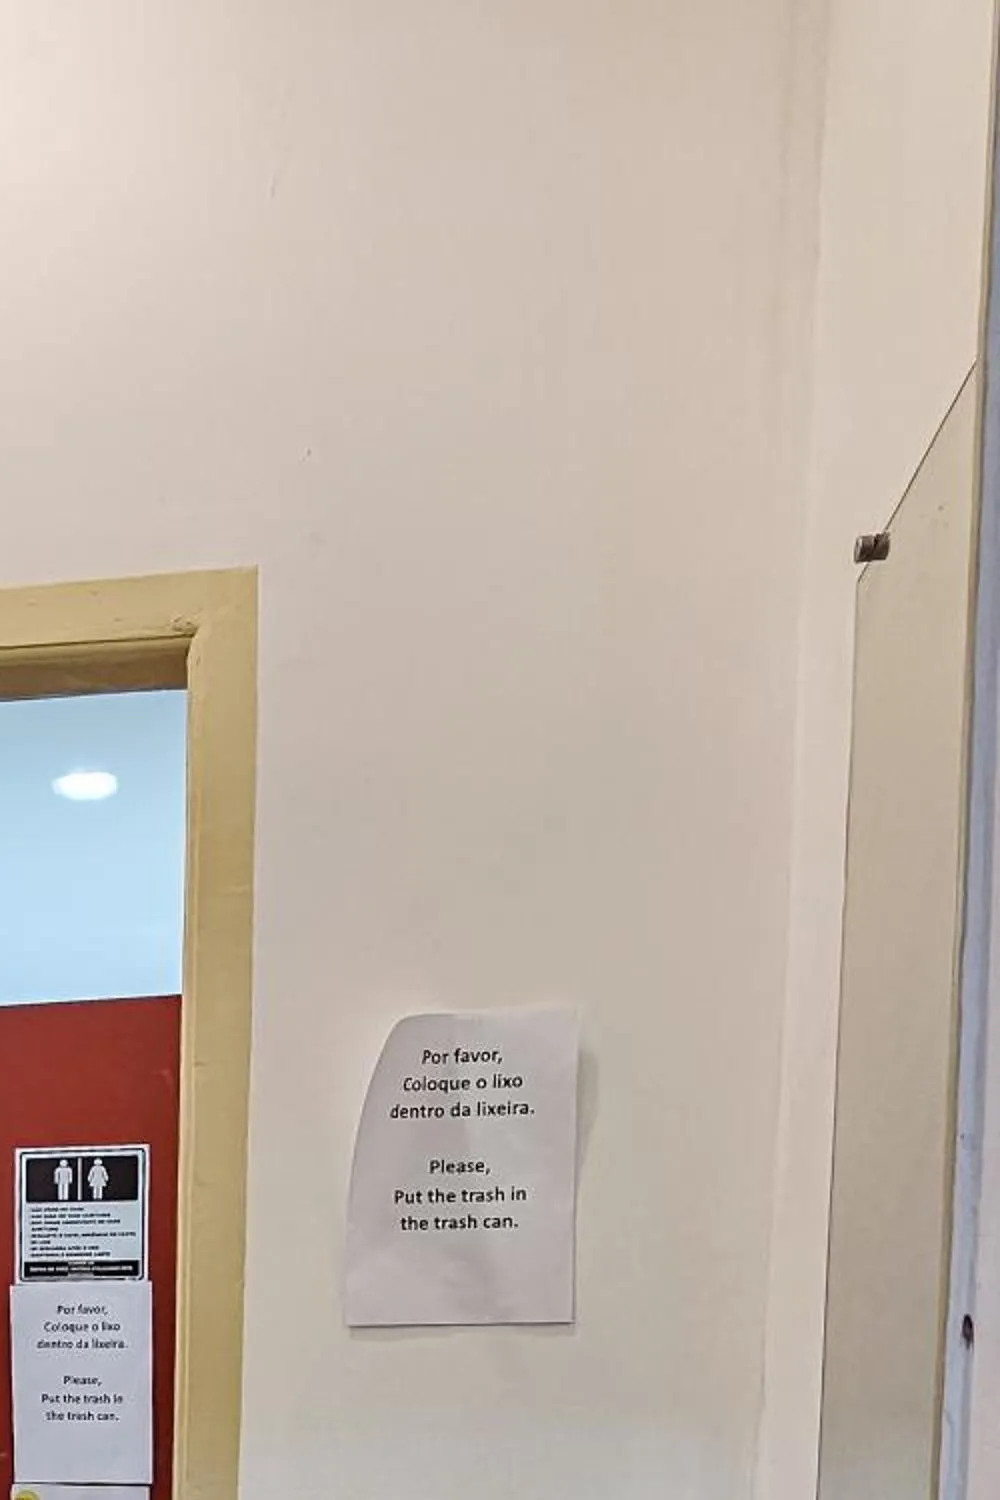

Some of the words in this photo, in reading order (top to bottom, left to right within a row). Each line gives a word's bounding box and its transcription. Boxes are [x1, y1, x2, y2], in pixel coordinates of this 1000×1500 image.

[422, 1050, 449, 1064] Por
[453, 1048, 503, 1065] favor,
[403, 1076, 470, 1093] Coloque
[476, 1079, 487, 1089] o
[492, 1075, 524, 1088] lixo
[390, 1104, 444, 1119] dentro
[450, 1102, 471, 1117] da
[477, 1100, 535, 1116] lixeira.
[429, 1159, 490, 1175] Please,
[394, 1190, 422, 1204] Put
[427, 1188, 456, 1204] the
[461, 1186, 505, 1203] trash
[511, 1186, 527, 1201] in
[400, 1216, 428, 1230] the
[434, 1214, 478, 1230] trash
[483, 1217, 519, 1229] can.
[91, 1323, 99, 1331] o
[75, 1339, 88, 1349] da
[63, 1394, 81, 1404] the
[46, 1410, 65, 1421] the
